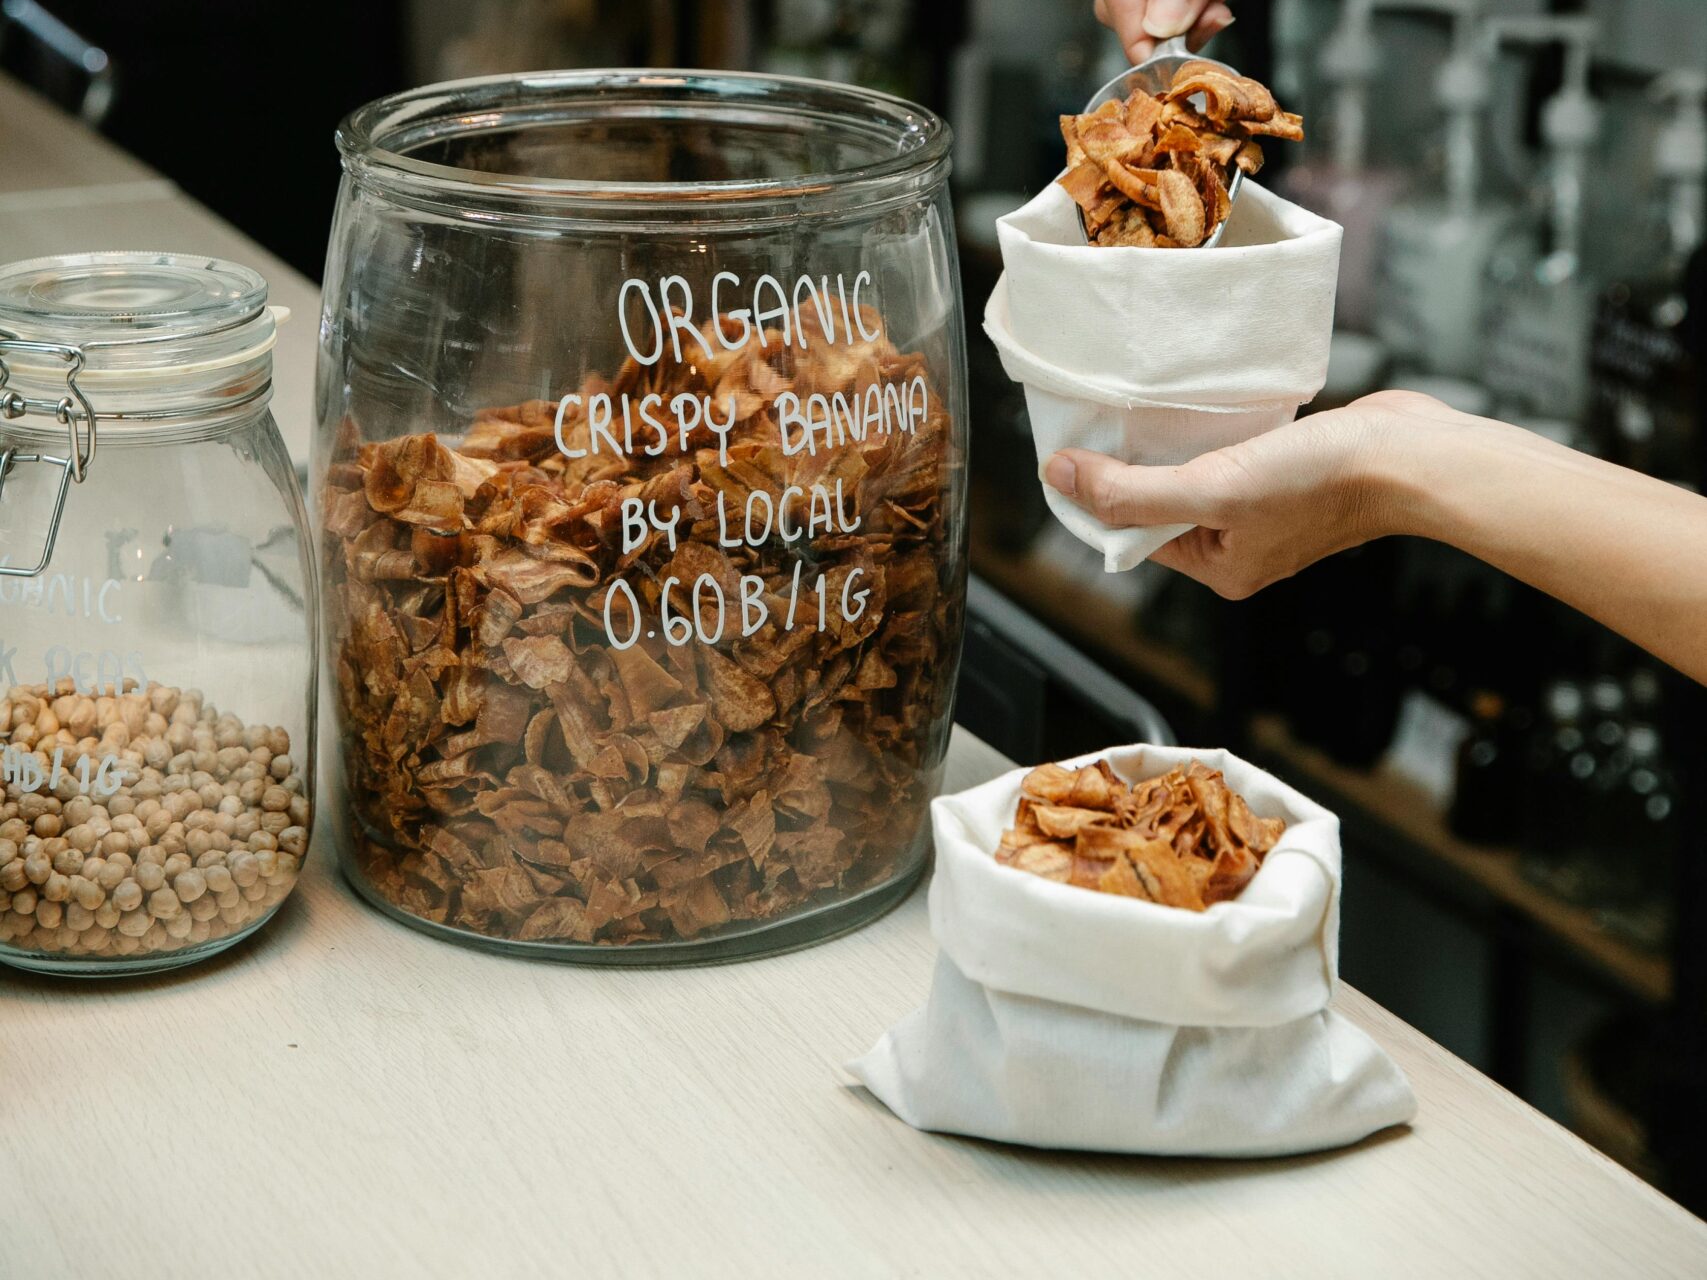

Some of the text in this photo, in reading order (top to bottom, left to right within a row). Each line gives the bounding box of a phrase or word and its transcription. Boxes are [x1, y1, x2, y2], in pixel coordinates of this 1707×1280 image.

[618, 270, 880, 366] ORGANIC
[554, 375, 929, 467] CRISPY BANANA
[621, 477, 861, 554] BY LOCAL
[44, 644, 149, 698] PEAS
[0, 742, 128, 797] HB/1G
